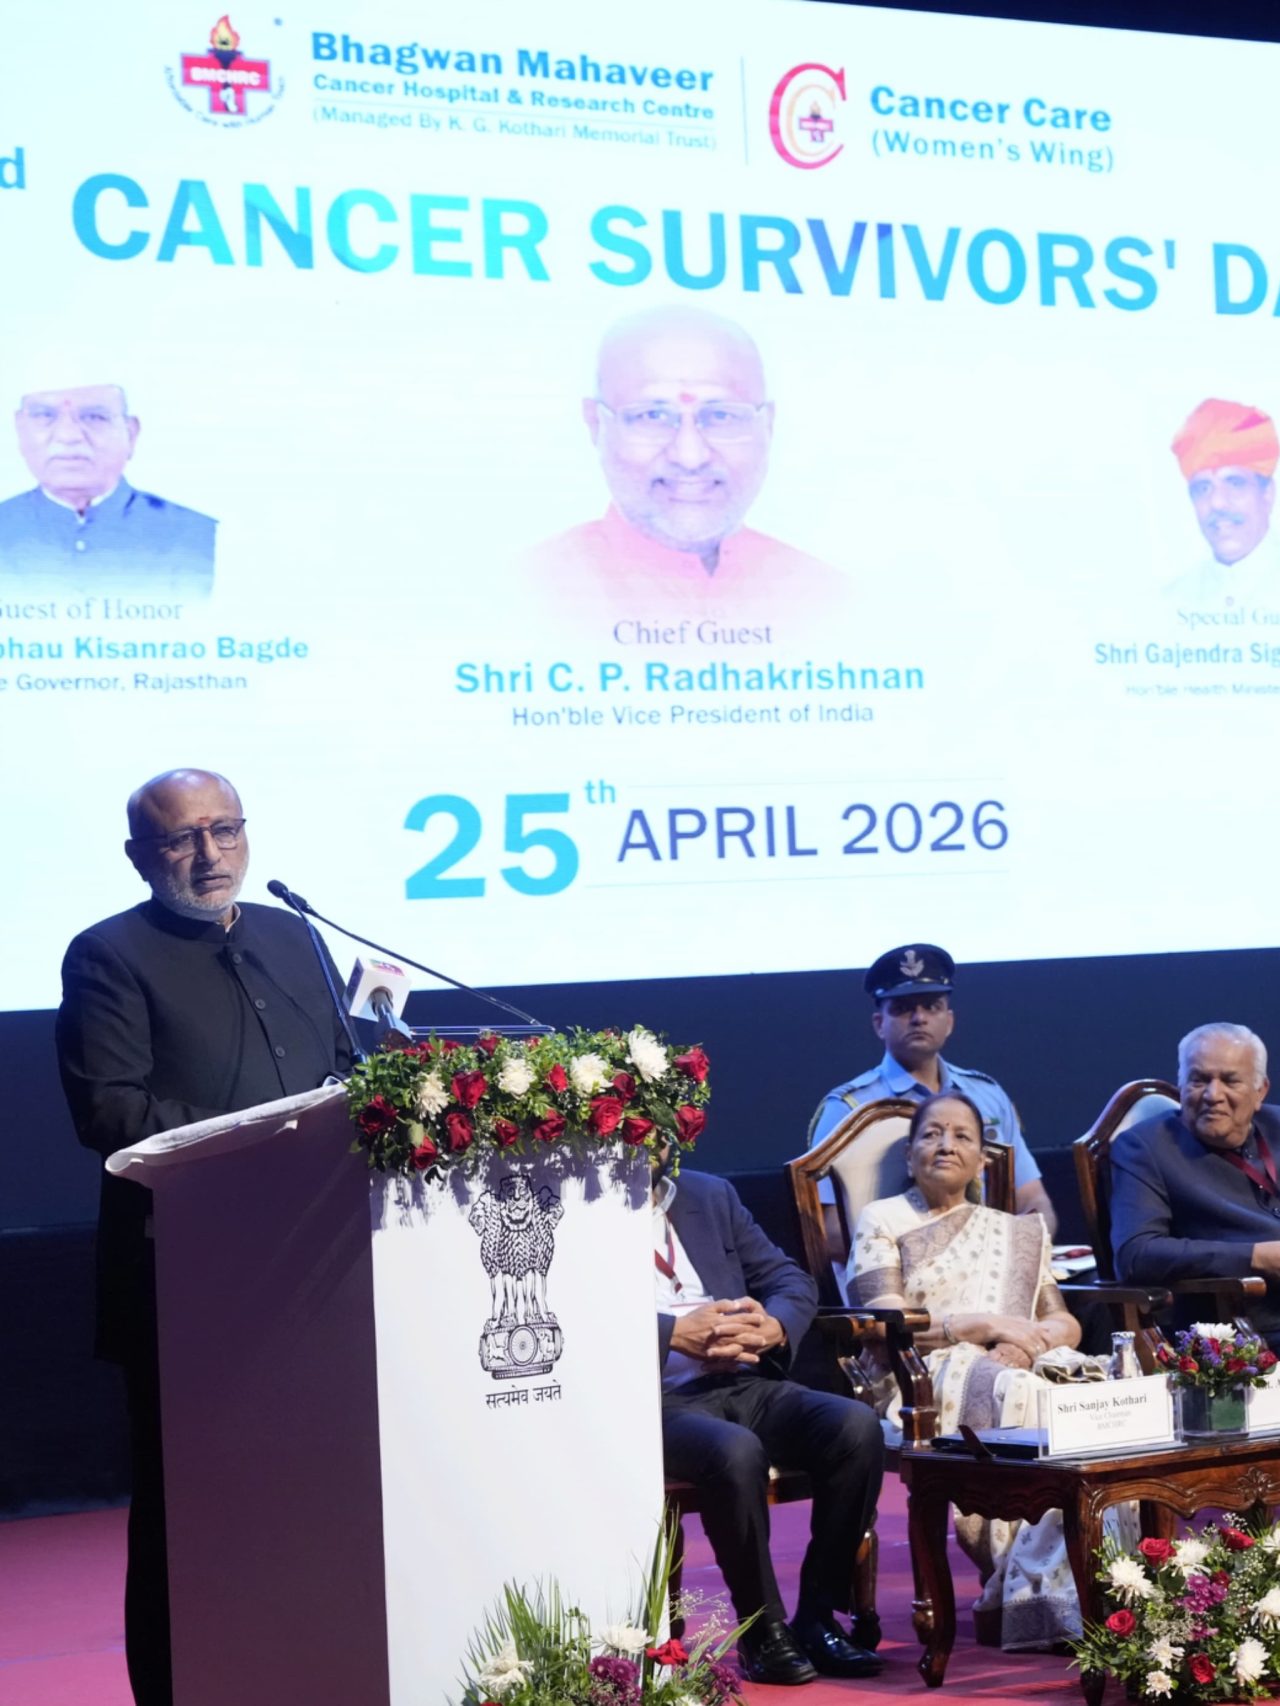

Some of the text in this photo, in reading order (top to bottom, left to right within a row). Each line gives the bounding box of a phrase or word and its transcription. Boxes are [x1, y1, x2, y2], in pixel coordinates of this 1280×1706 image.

[311, 31, 714, 91] Bhagwan Mahaveer
[313, 73, 714, 119] Cancer Hospital & Research Centre
[869, 85, 1112, 132] Cancer Care
[313, 105, 412, 129] (Managed
[419, 112, 441, 132] By
[499, 119, 566, 138] Kothari
[572, 124, 660, 146] Memorial
[667, 131, 717, 151] Trust)
[872, 128, 1114, 174] (Women's Wing)
[71, 172, 552, 284] CANCER
[588, 204, 1177, 312] SURVIVORS'
[0, 597, 184, 621] uest of Honor
[1175, 606, 1246, 631] Special
[612, 619, 773, 646] Chief Guest
[74, 635, 206, 660] Kisanrao
[216, 635, 309, 664] Bagde
[1094, 641, 1139, 665] Shri
[1145, 641, 1243, 668] Gajendra
[16, 672, 126, 693] Governor,
[133, 671, 248, 694] Rajasthan
[454, 660, 926, 694] Shri C. P. Radhakrishnan
[512, 702, 875, 727] Hon'ble Vice President of India
[402, 779, 617, 900] 25 th
[617, 799, 1011, 863] APRIL 2026
[485, 1379, 562, 1409] सत्यमेव जयते
[1057, 1392, 1148, 1415] Shri Sanjay Kothari
